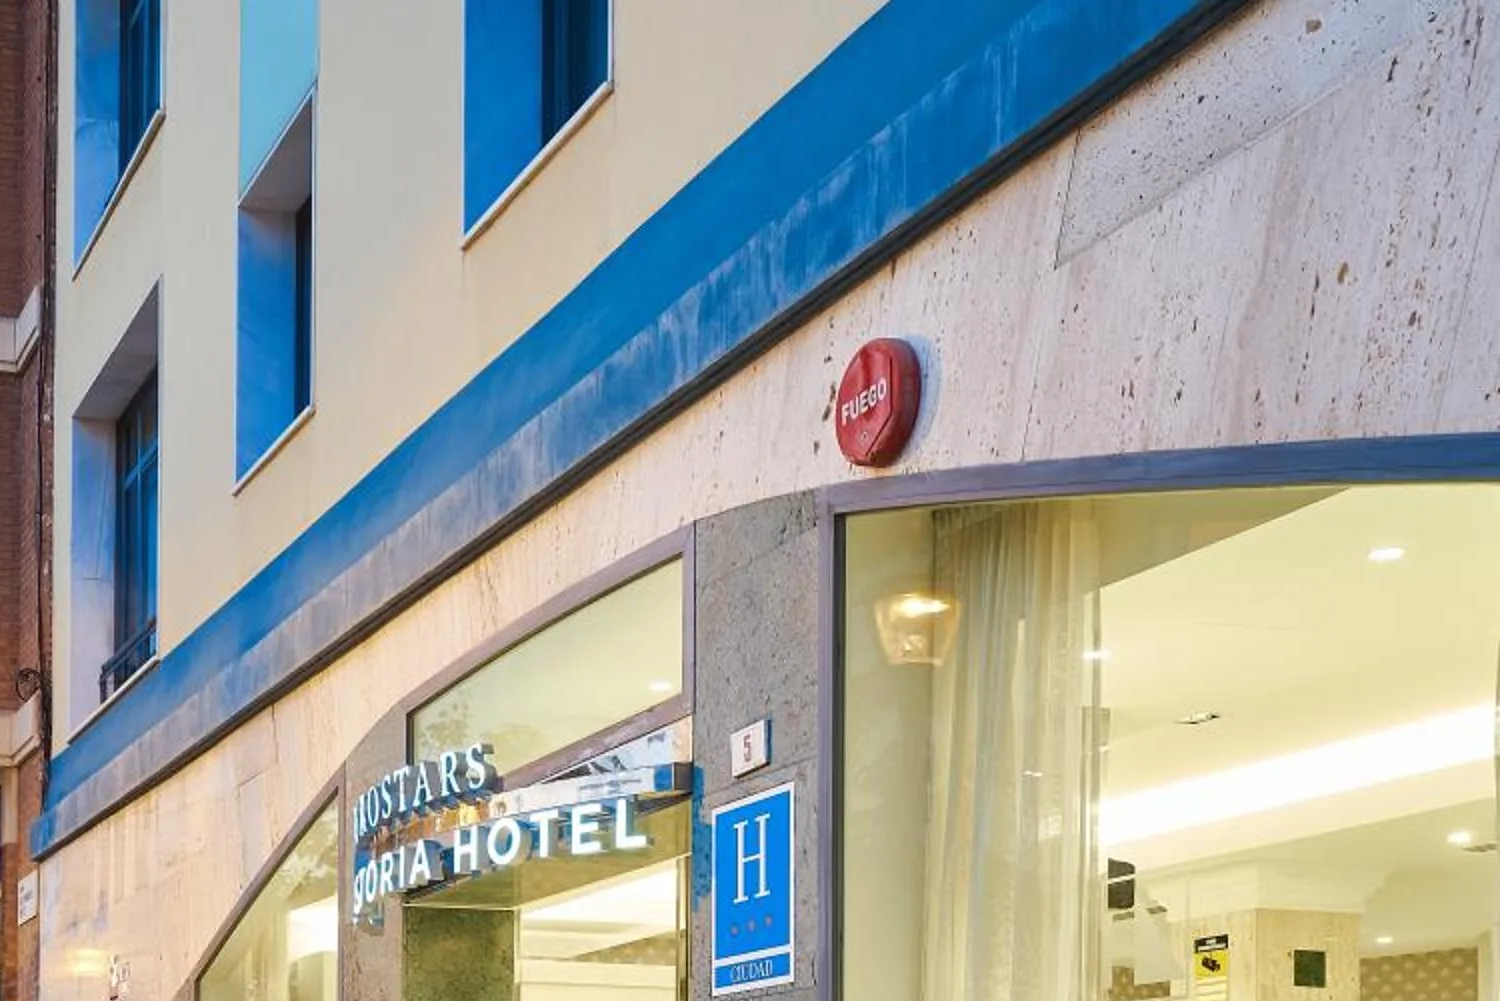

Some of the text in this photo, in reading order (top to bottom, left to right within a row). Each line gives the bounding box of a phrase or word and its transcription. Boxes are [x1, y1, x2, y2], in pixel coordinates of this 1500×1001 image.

[841, 377, 887, 426] FUEGO
[742, 734, 753, 763] 5
[453, 799, 647, 874] HOTEL
[732, 813, 771, 905] H
[729, 959, 774, 983] CIUDAD
